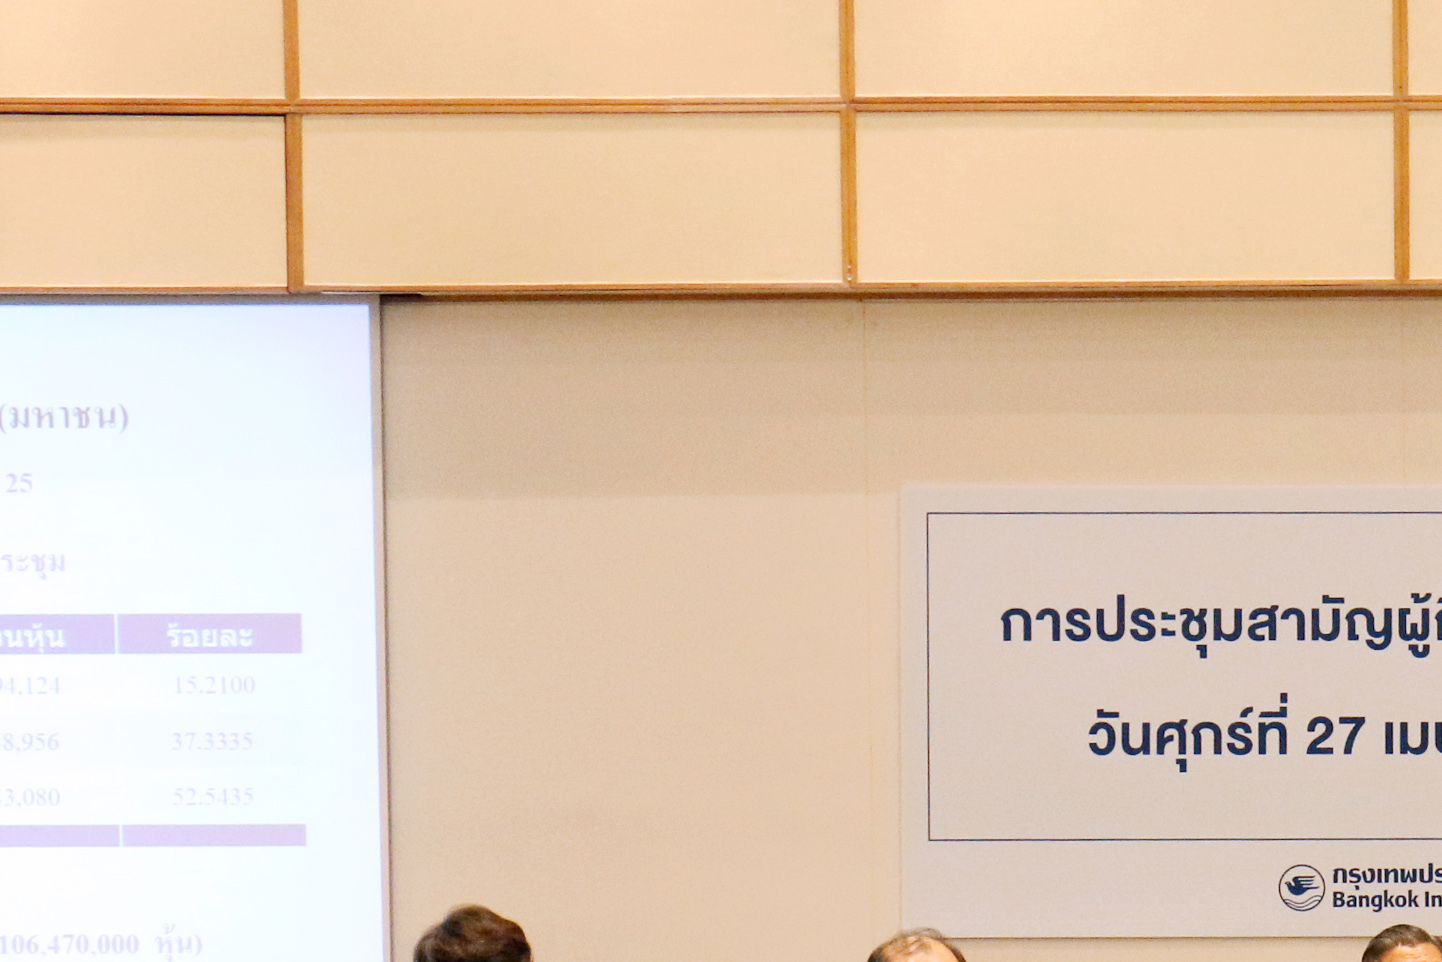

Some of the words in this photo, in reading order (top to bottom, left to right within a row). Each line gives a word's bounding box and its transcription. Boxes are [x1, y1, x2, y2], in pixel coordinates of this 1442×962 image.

[0, 404, 129, 434] (มหาชน)
[5, 472, 33, 494] 25
[0, 622, 66, 653] นหุ้น
[166, 622, 253, 648] ร้อยละ
[175, 675, 256, 695] 15.2100
[0, 732, 60, 752] 8,956
[171, 731, 254, 751] 37.3335
[1088, 692, 1289, 773] วันศุกร์ที่
[1306, 715, 1366, 755] 27
[172, 786, 254, 807] 52.5435
[1332, 889, 1420, 913] Bangkok
[0, 933, 140, 956] 106,470,000
[154, 923, 203, 962] หุ้น)
